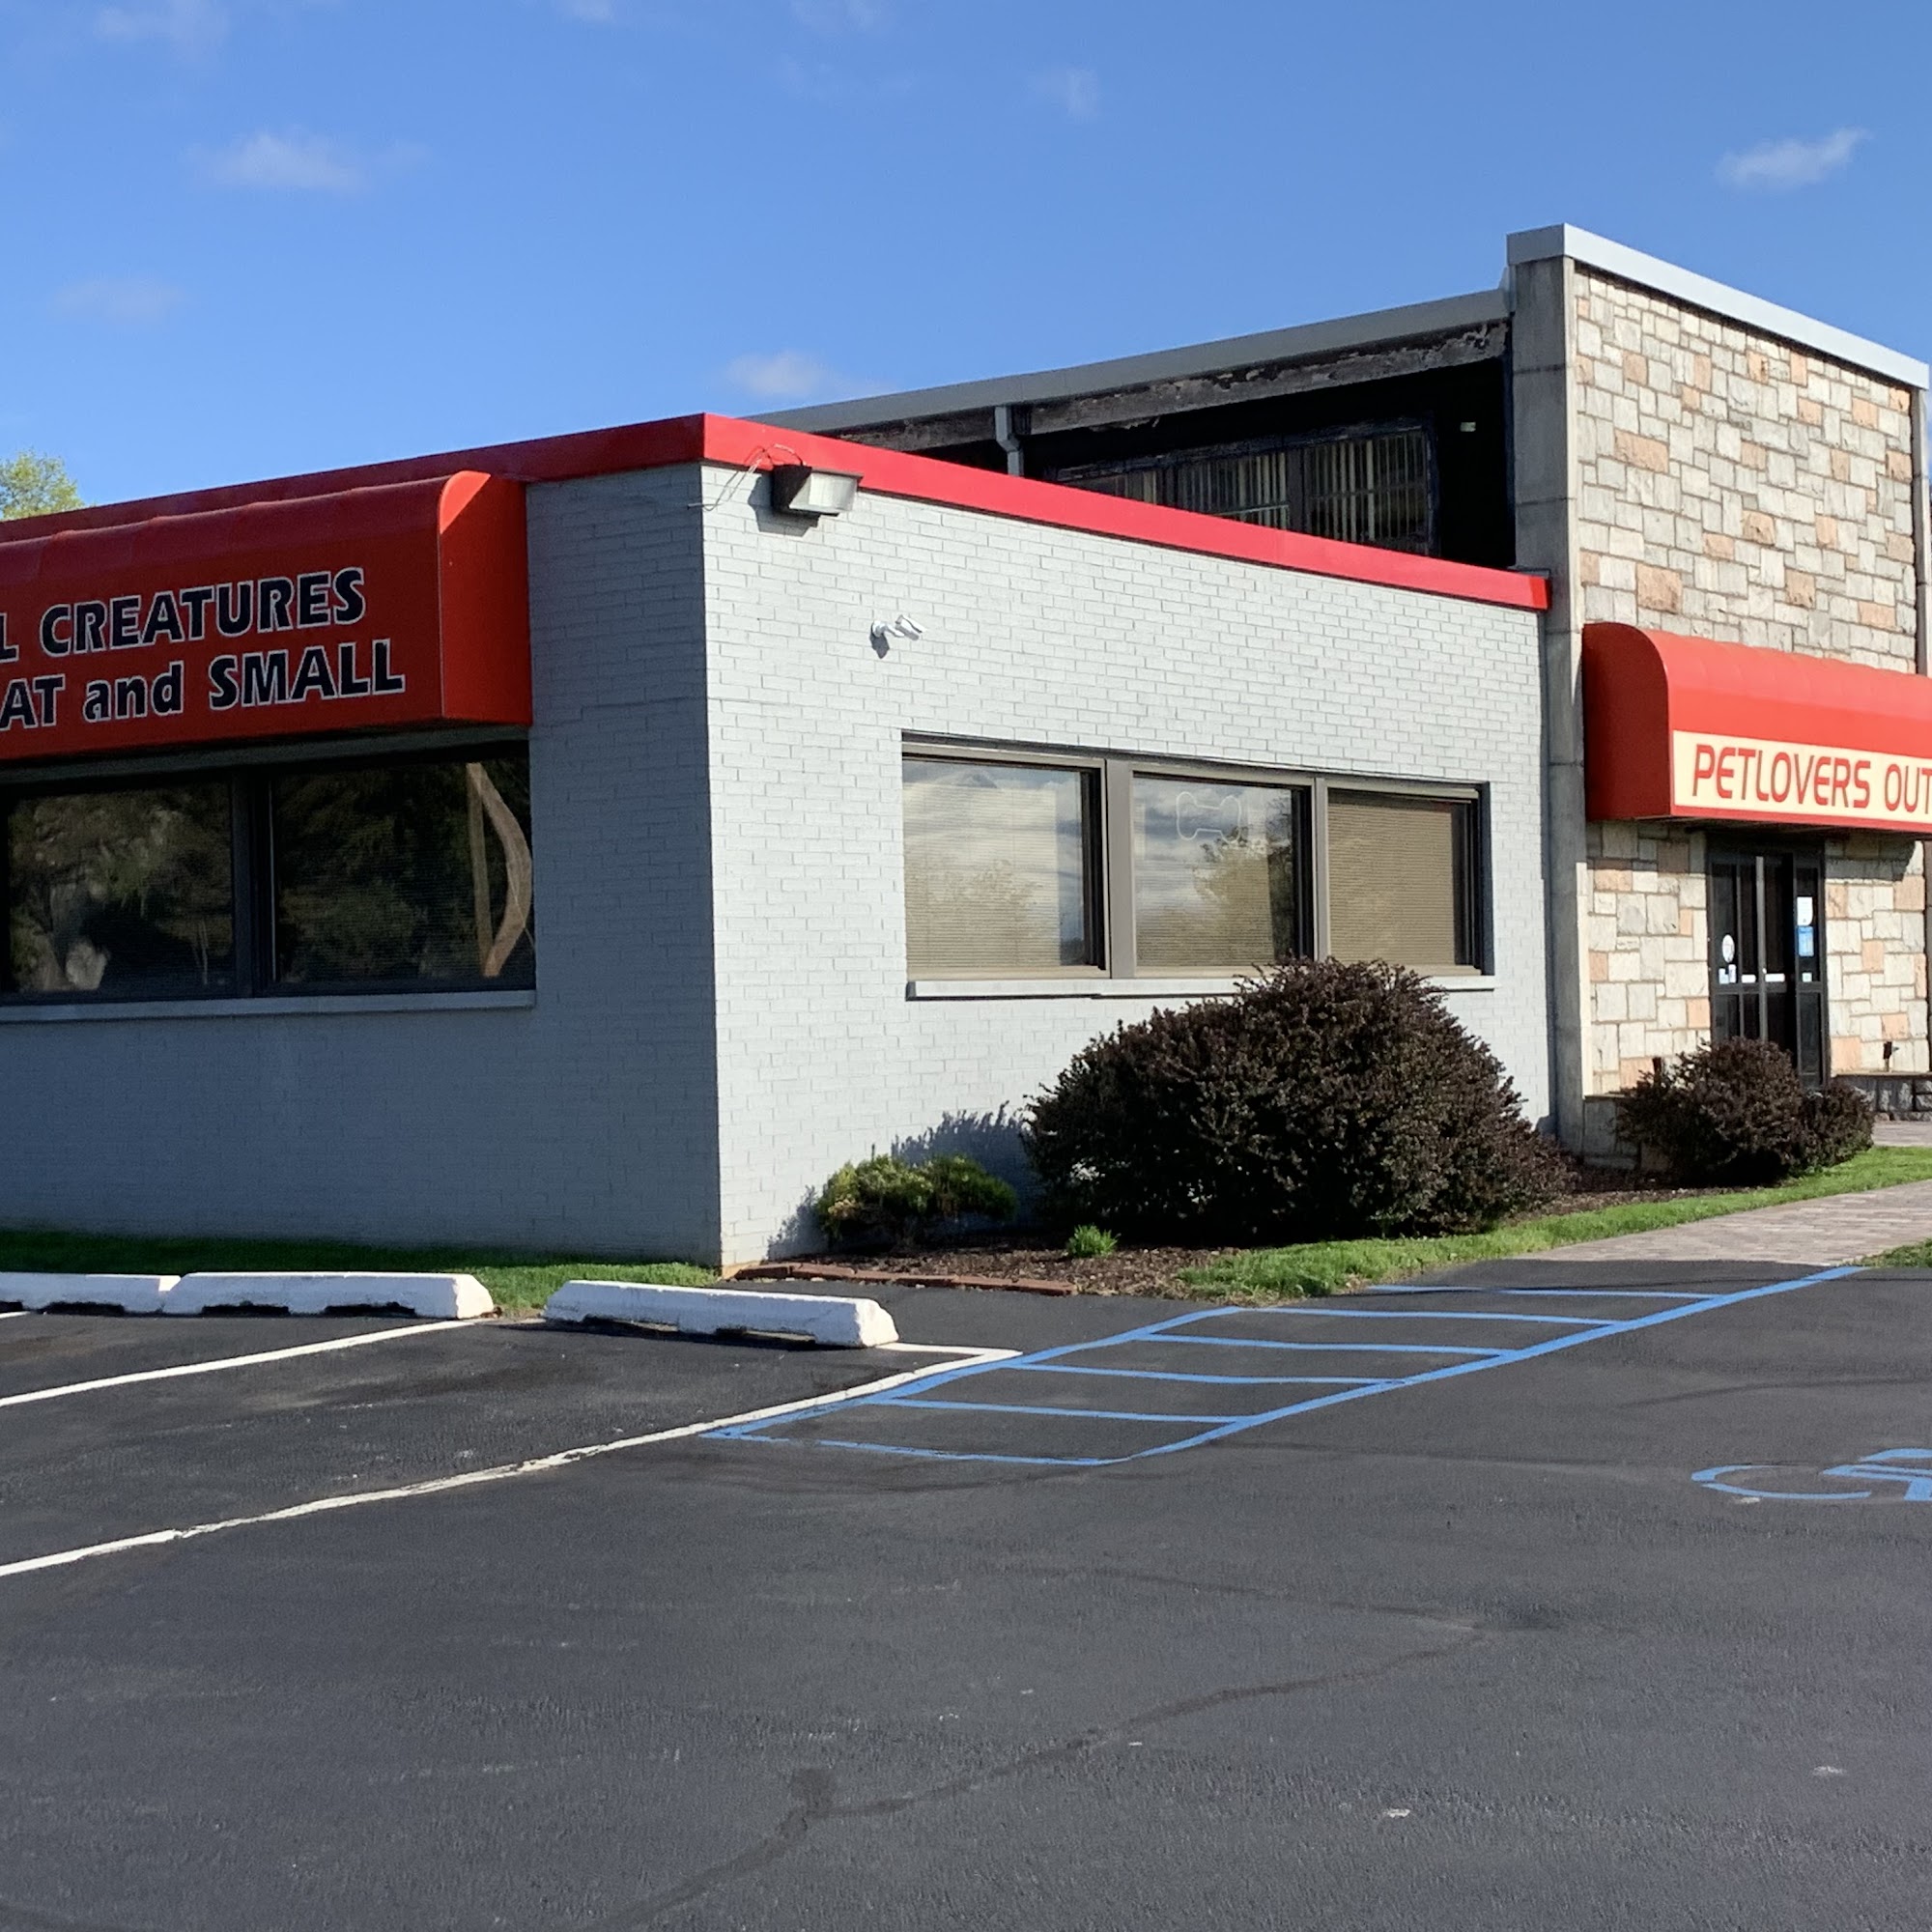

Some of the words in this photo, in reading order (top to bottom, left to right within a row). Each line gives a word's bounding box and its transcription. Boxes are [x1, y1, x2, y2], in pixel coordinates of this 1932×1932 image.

[40, 566, 366, 658] CREATURES
[83, 661, 185, 723] and
[209, 639, 406, 711] SMALL
[1691, 743, 1871, 810] PETLOVERS
